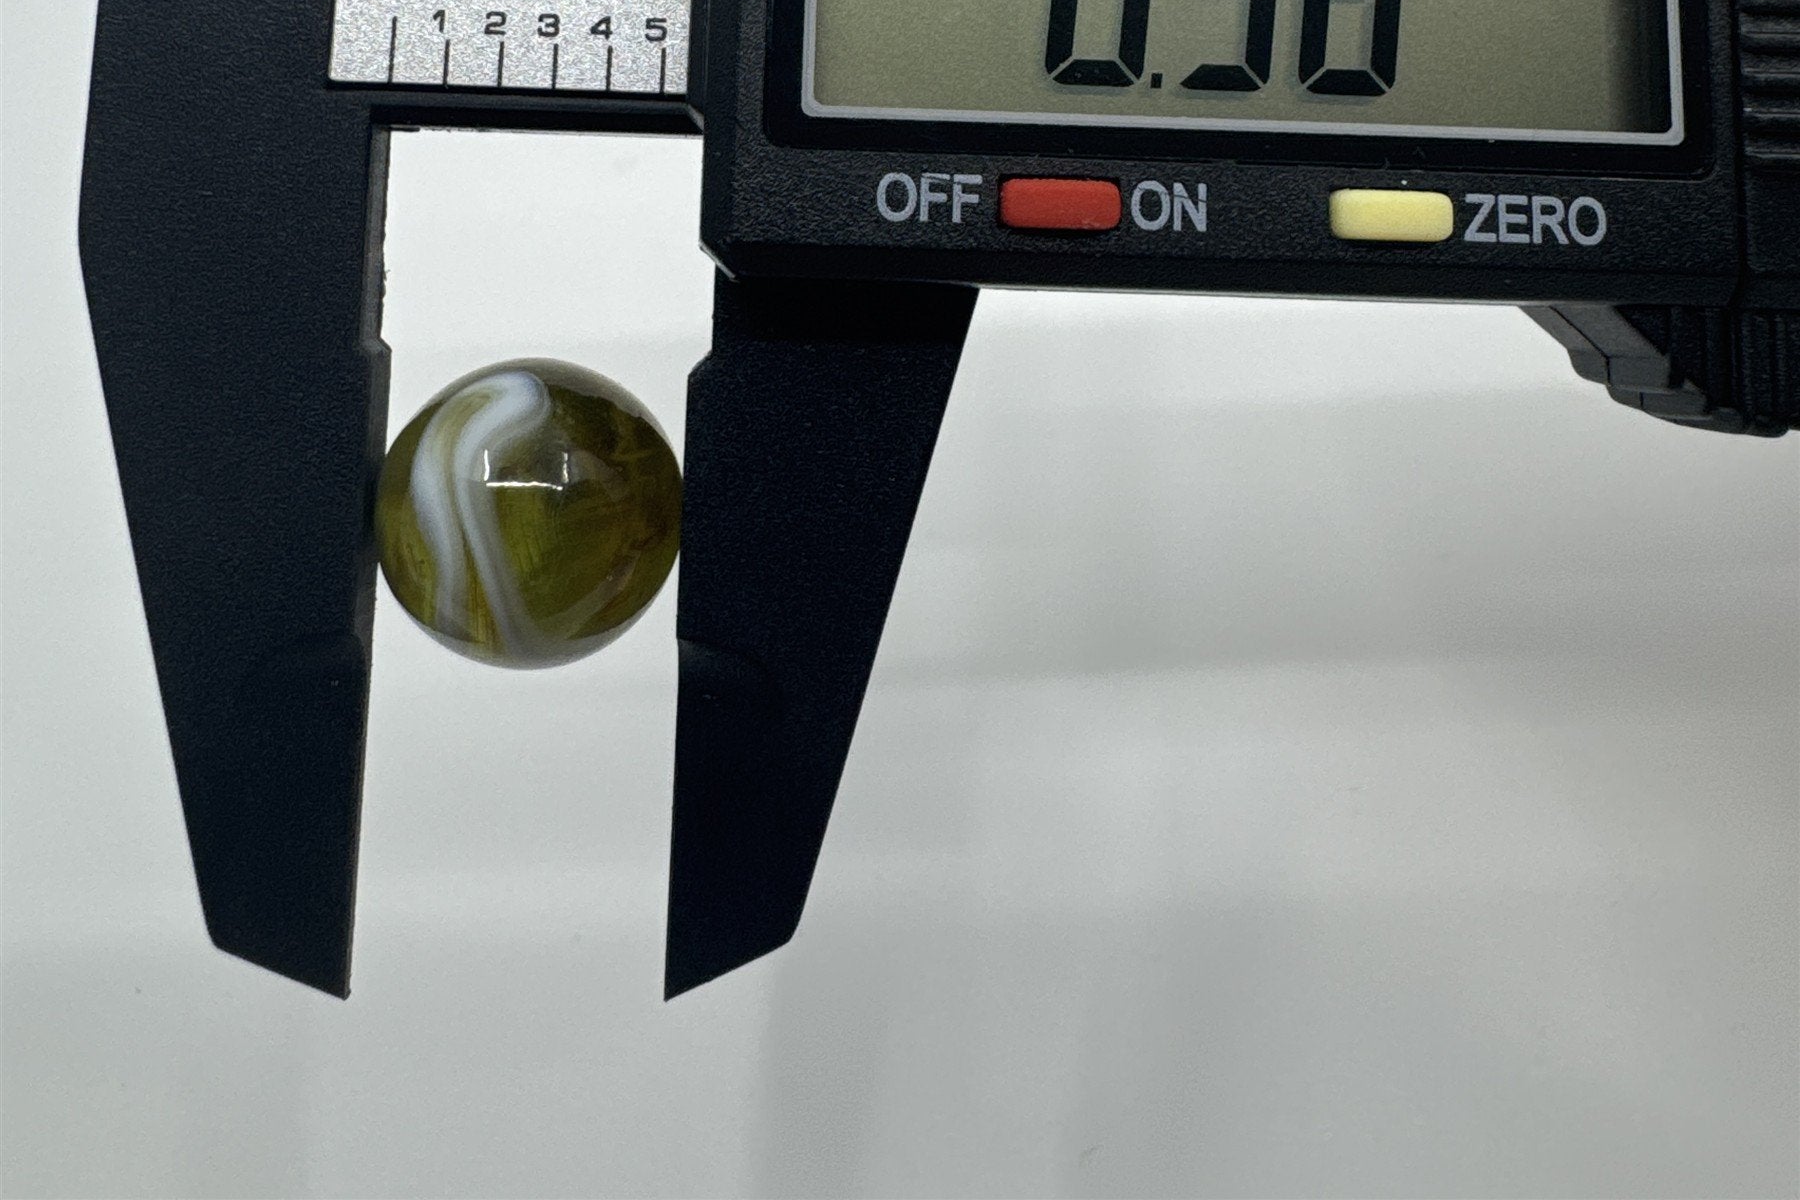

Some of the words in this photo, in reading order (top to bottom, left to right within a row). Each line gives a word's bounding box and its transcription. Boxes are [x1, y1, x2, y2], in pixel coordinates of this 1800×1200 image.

[432, 10, 446, 33] 1
[484, 11, 507, 35] 2
[537, 13, 560, 37] 3
[590, 16, 613, 39] 4
[645, 18, 667, 42] 5
[876, 172, 983, 224] OFF
[1131, 180, 1208, 232] ON
[1464, 193, 1608, 246] ZERO
